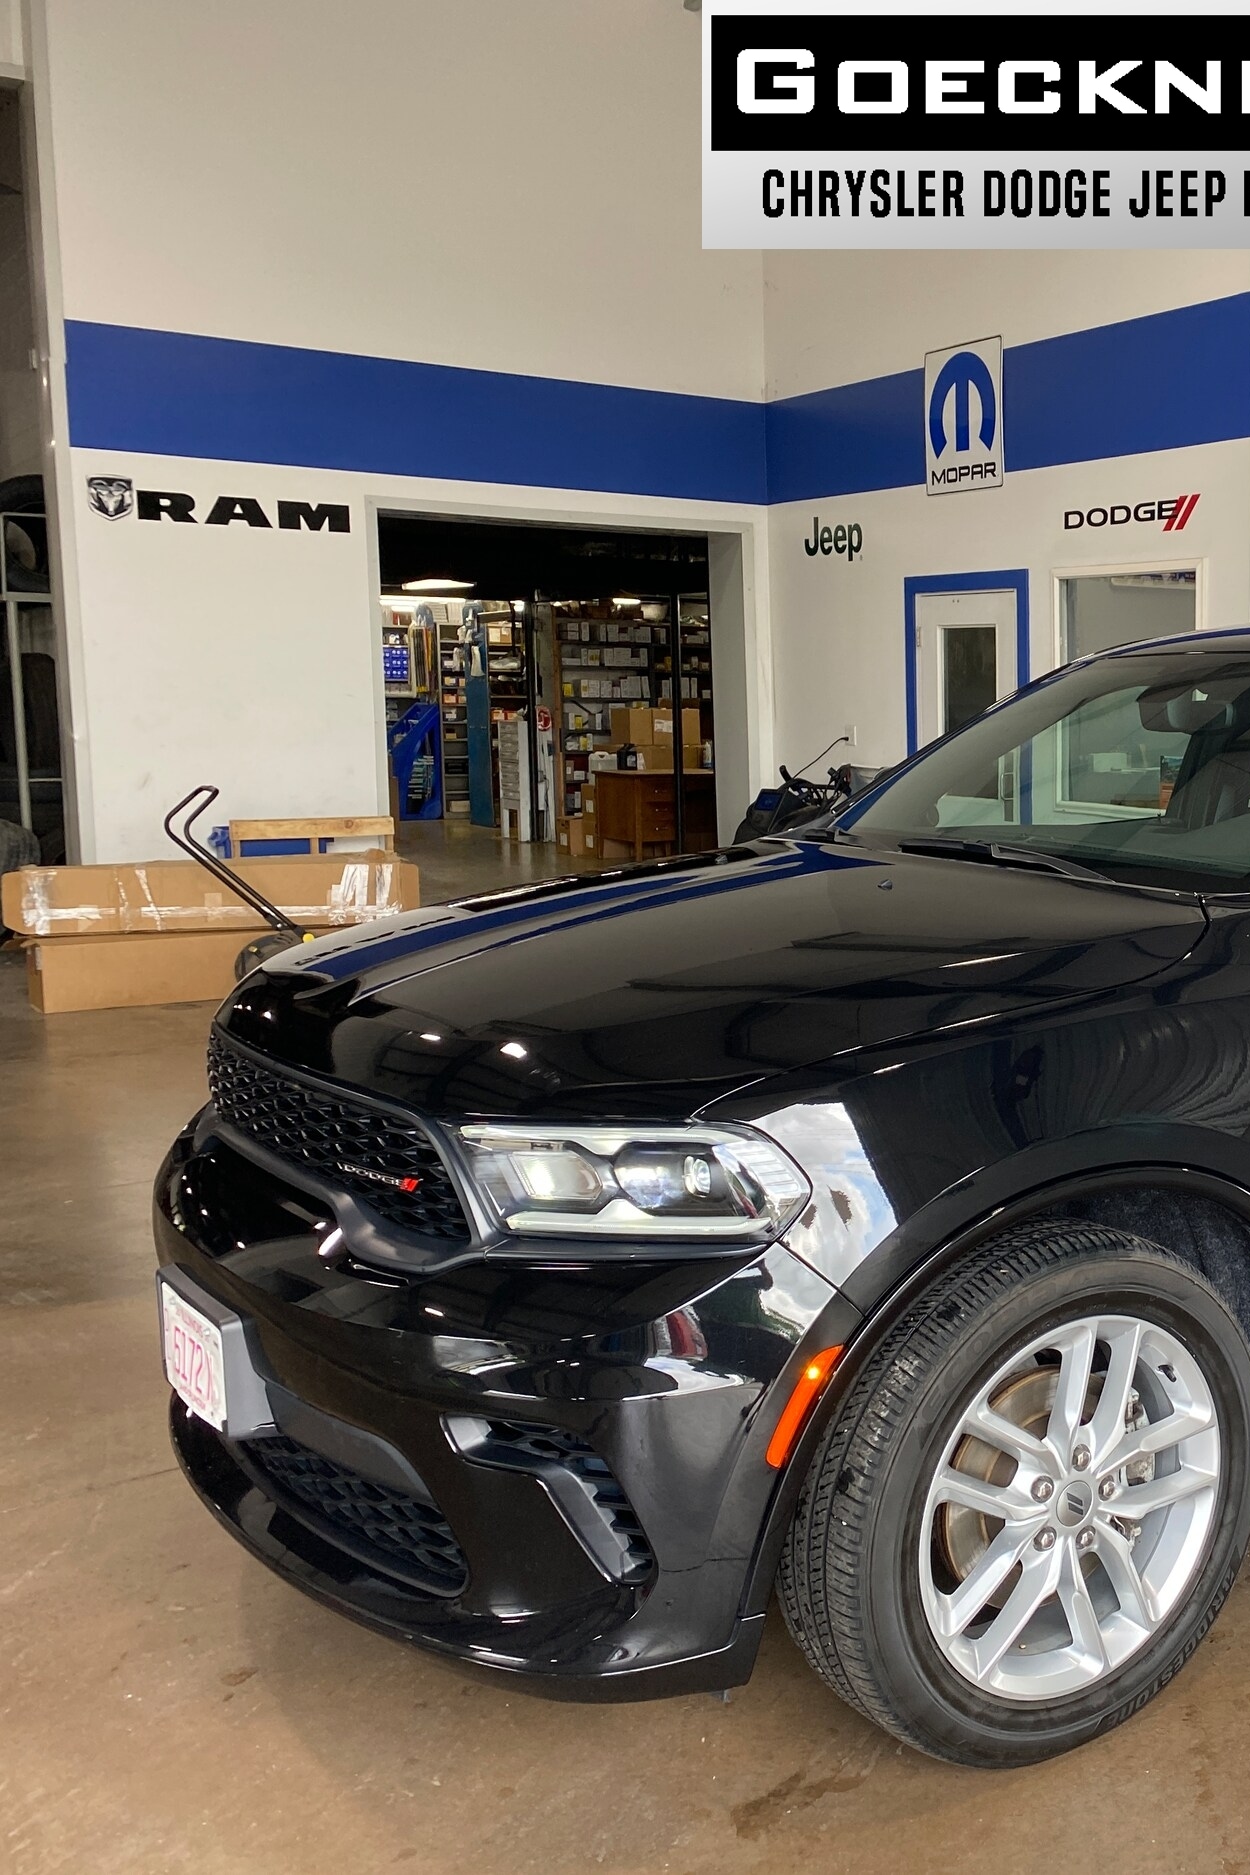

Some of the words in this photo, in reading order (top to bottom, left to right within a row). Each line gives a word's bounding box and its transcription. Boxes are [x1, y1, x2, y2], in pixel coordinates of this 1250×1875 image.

[931, 461, 998, 487] MOPAR
[136, 489, 351, 533] RAM
[1064, 498, 1180, 530] DODGE
[804, 516, 863, 561] Jeep
[344, 1163, 409, 1190] DODGE
